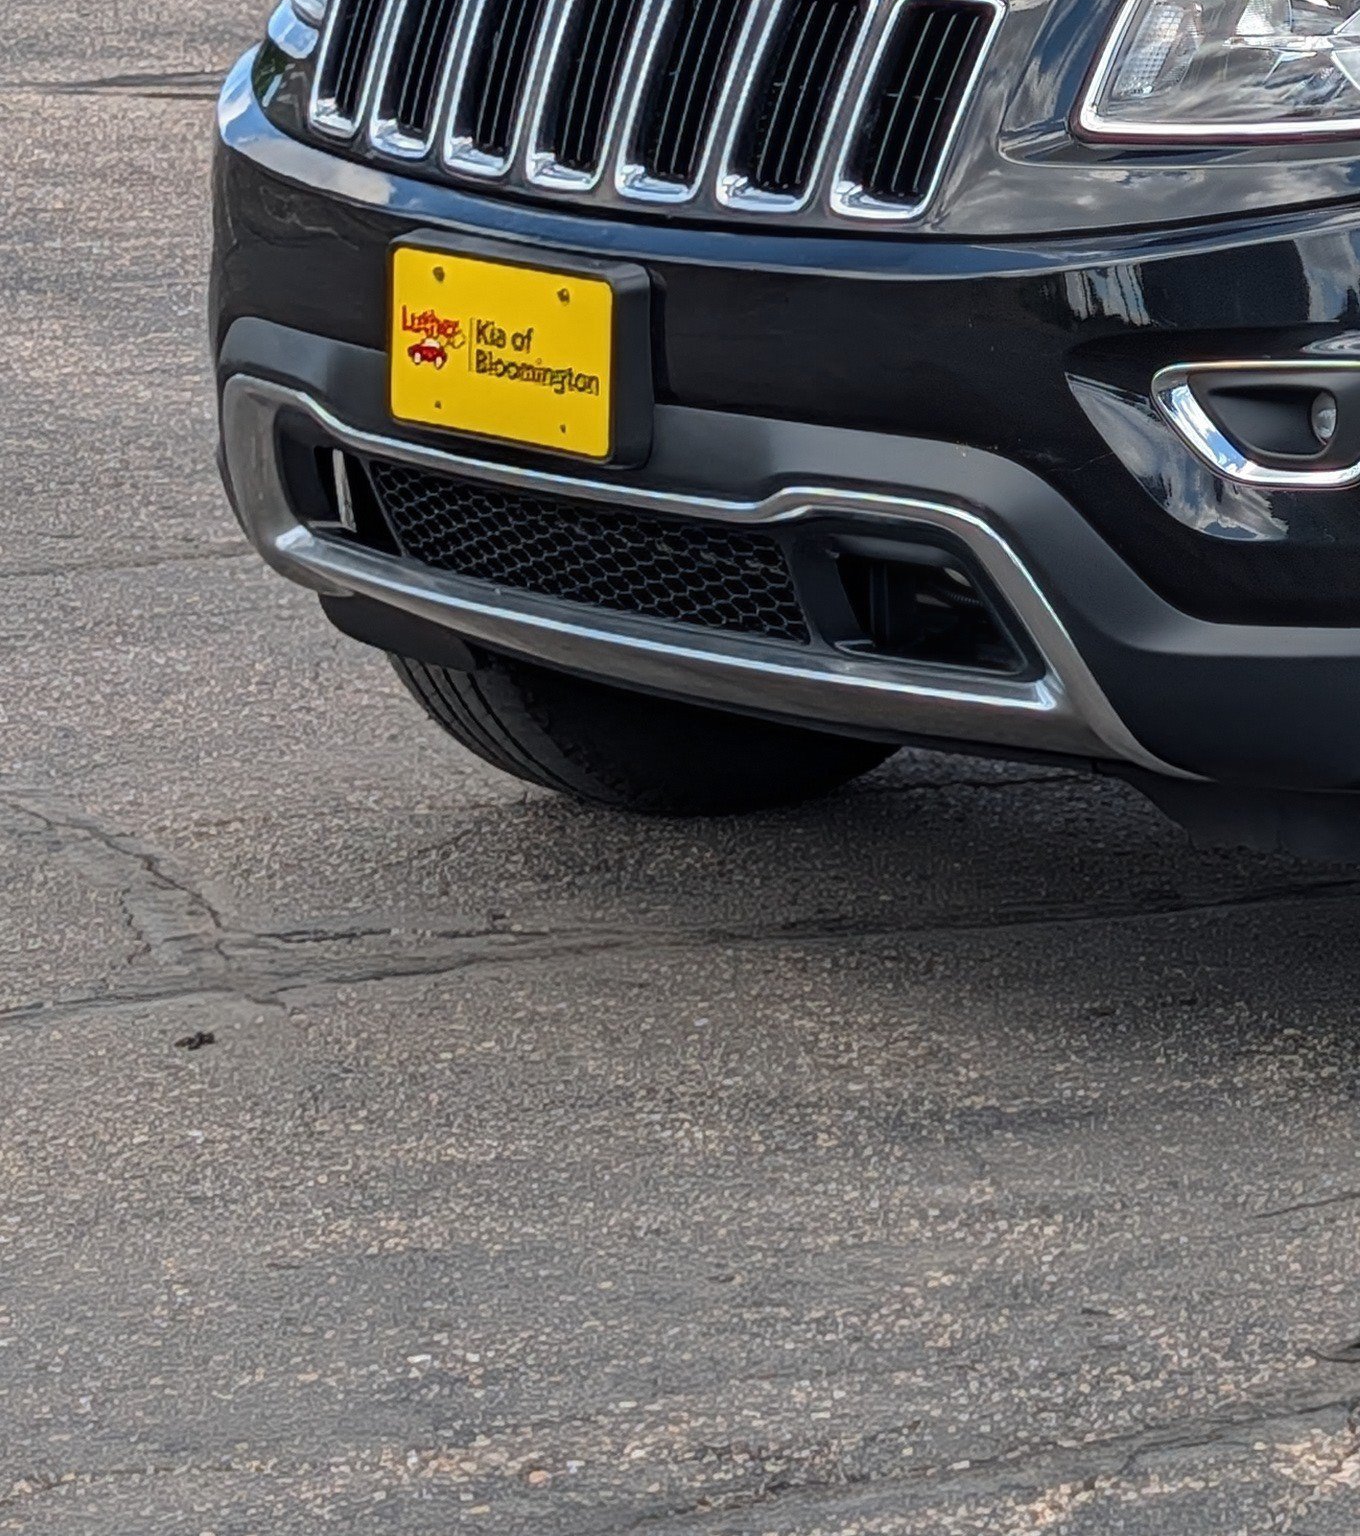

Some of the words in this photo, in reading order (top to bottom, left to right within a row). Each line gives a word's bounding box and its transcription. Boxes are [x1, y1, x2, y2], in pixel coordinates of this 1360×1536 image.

[475, 319, 506, 349] Kia
[511, 328, 534, 353] of
[475, 349, 600, 395] Bloomington
